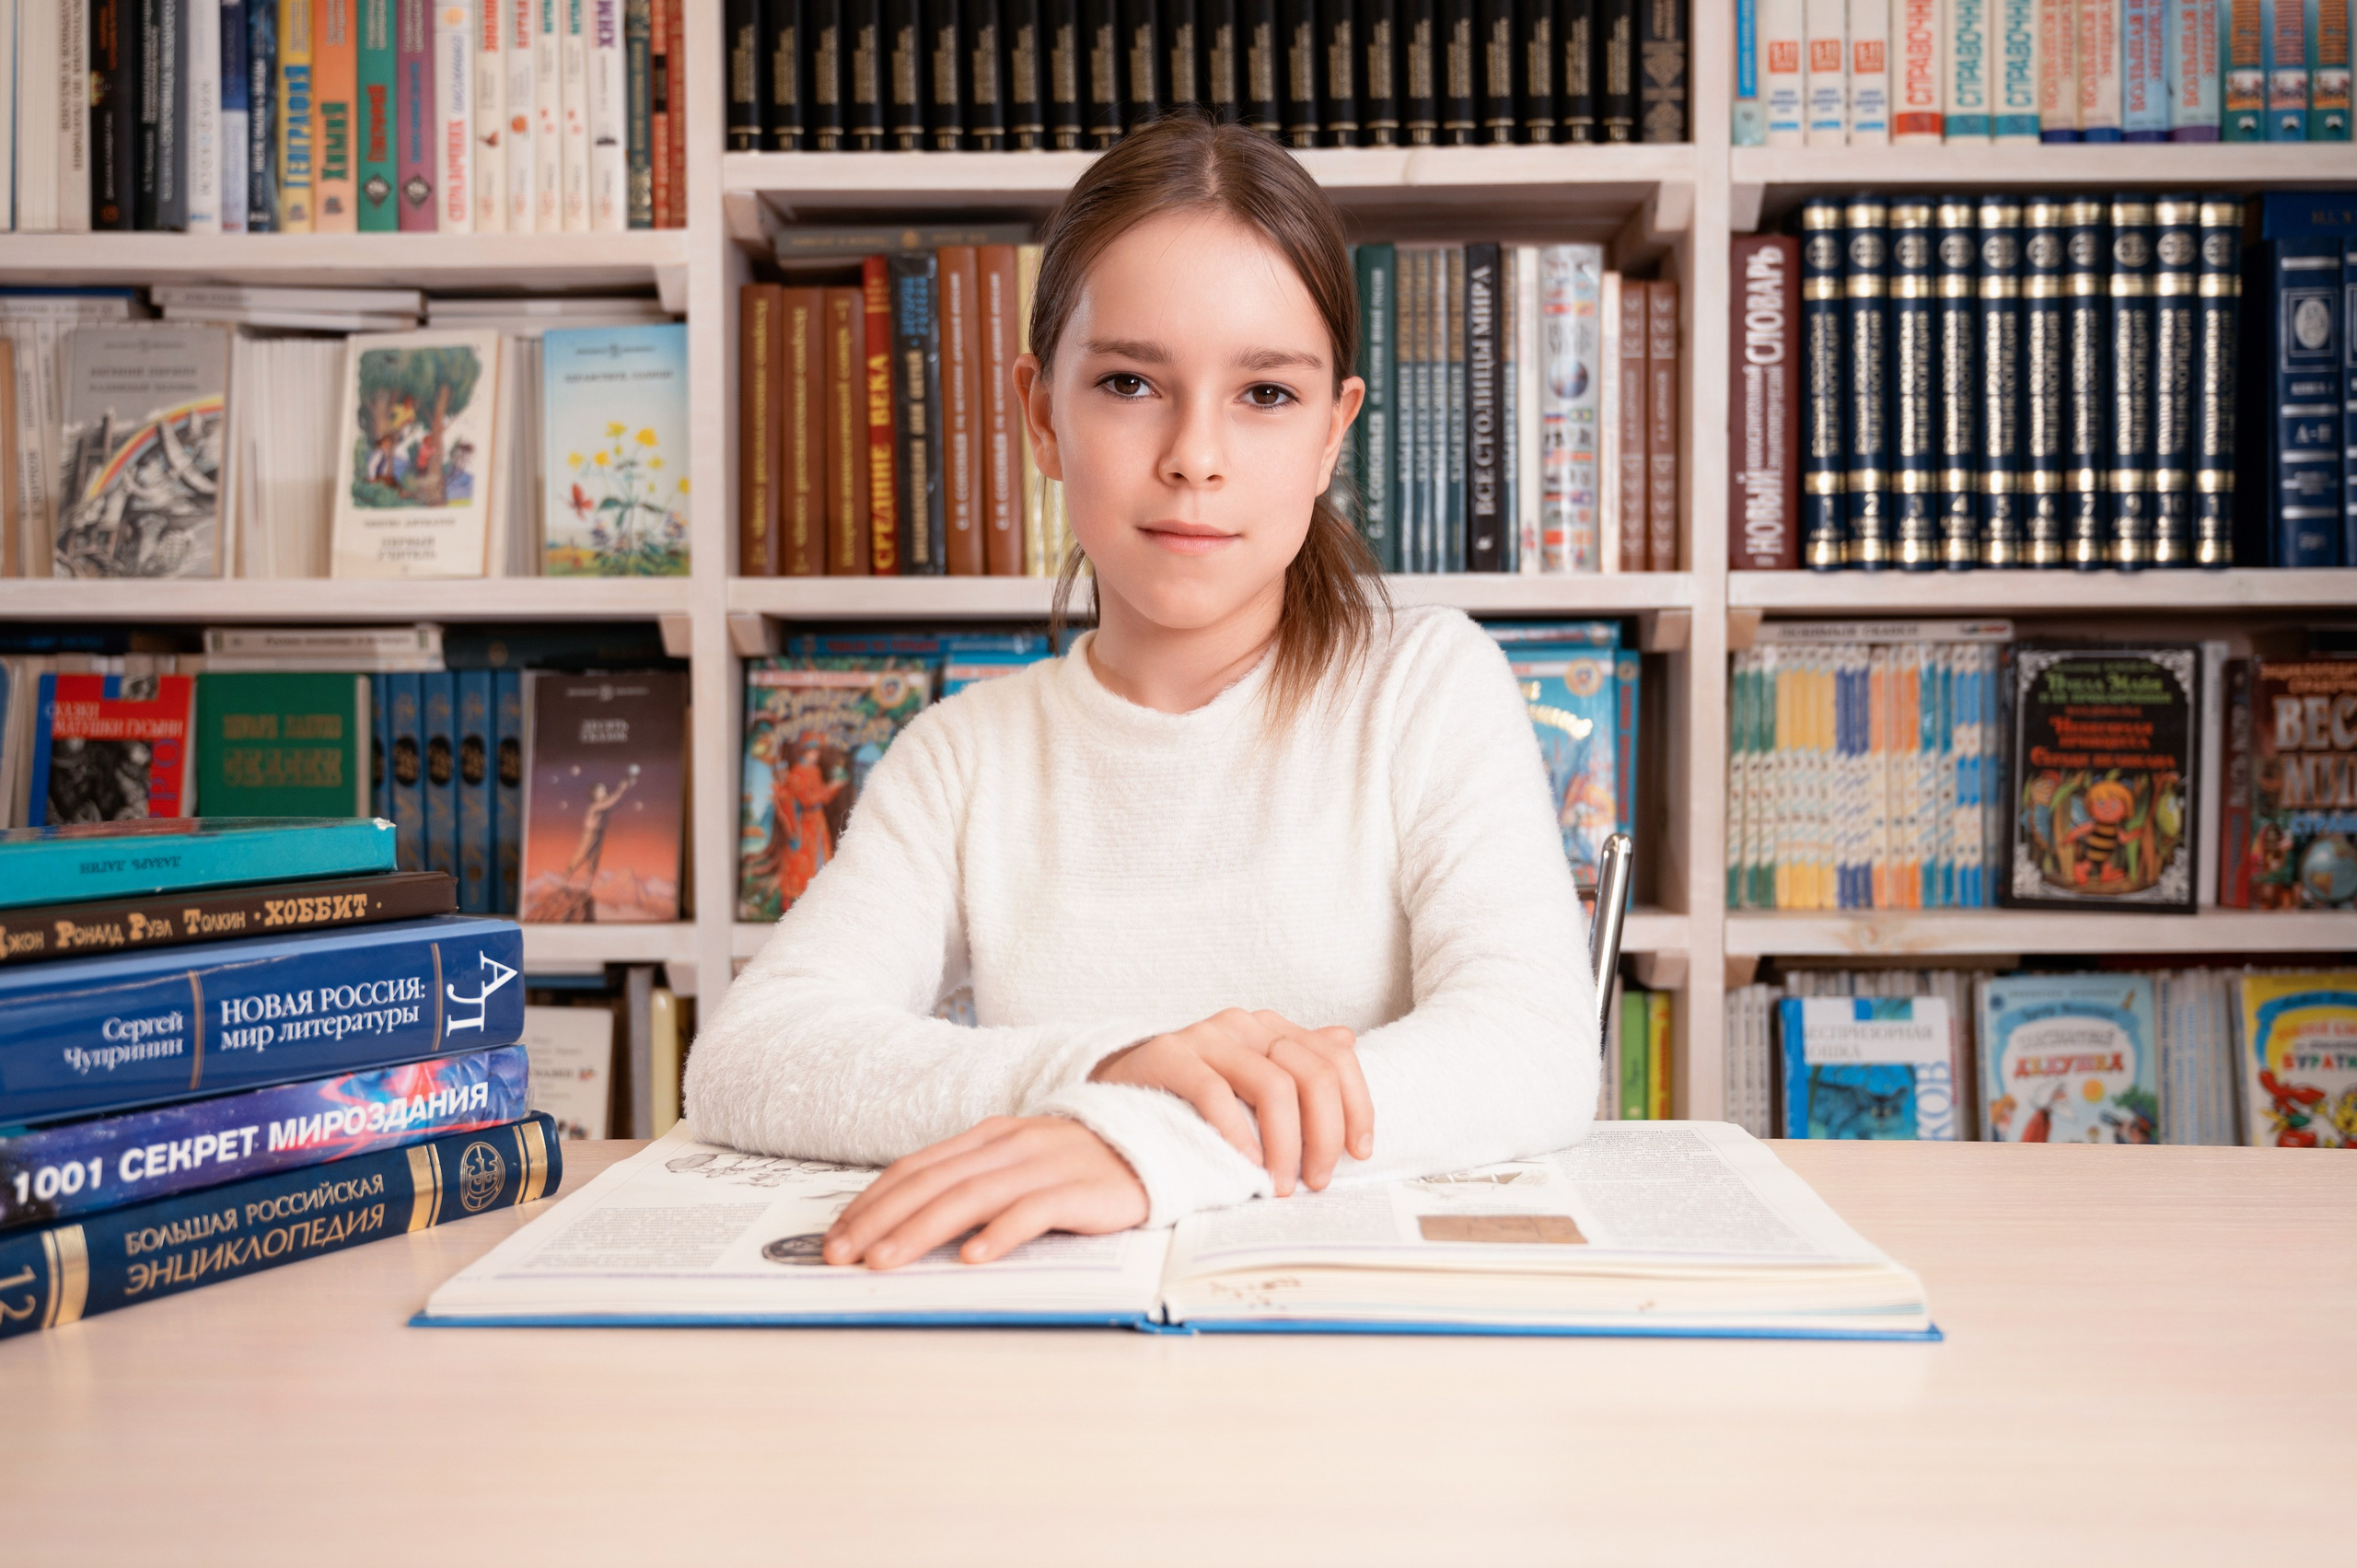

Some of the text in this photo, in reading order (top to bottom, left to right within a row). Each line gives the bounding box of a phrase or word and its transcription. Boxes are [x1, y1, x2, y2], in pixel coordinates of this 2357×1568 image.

[320, 101, 349, 181] ХИМИЯ
[1744, 245, 1786, 365] СЛОВАРЬ
[1469, 264, 1496, 517] ВСЕ СТОЛИЦЫ МИРА
[868, 354, 895, 570] СРЕДНИЕ ВЕКА
[1736, 469, 1785, 555] НОВЫЙ
[1864, 493, 1880, 516] 2
[1951, 493, 1968, 515] 4
[2037, 494, 2055, 517] 6
[2082, 493, 2096, 516] 7
[2124, 494, 2142, 517] 9
[44, 701, 100, 718] СКАЗКИ
[52, 718, 184, 738] МАТУШКИ ГУСЫНИ
[79, 854, 182, 876] ЛАЗАРЬ ЛАГИН
[263, 893, 368, 926] ХОББИТ
[220, 976, 426, 1026] НОВАЯ РОССИЯ:
[101, 1010, 185, 1042] Сергей
[220, 1003, 420, 1053] мир литературы
[63, 1035, 185, 1075] Чупринин
[13, 1080, 490, 1204] 1001 СЕКРЕТ МИРОЗДАНИЯ
[125, 1172, 385, 1258] БОЛЬШАЯ РОССИЙСКАЯ
[124, 1203, 385, 1296] ЭНЦИКЛОПЕДИЯ
